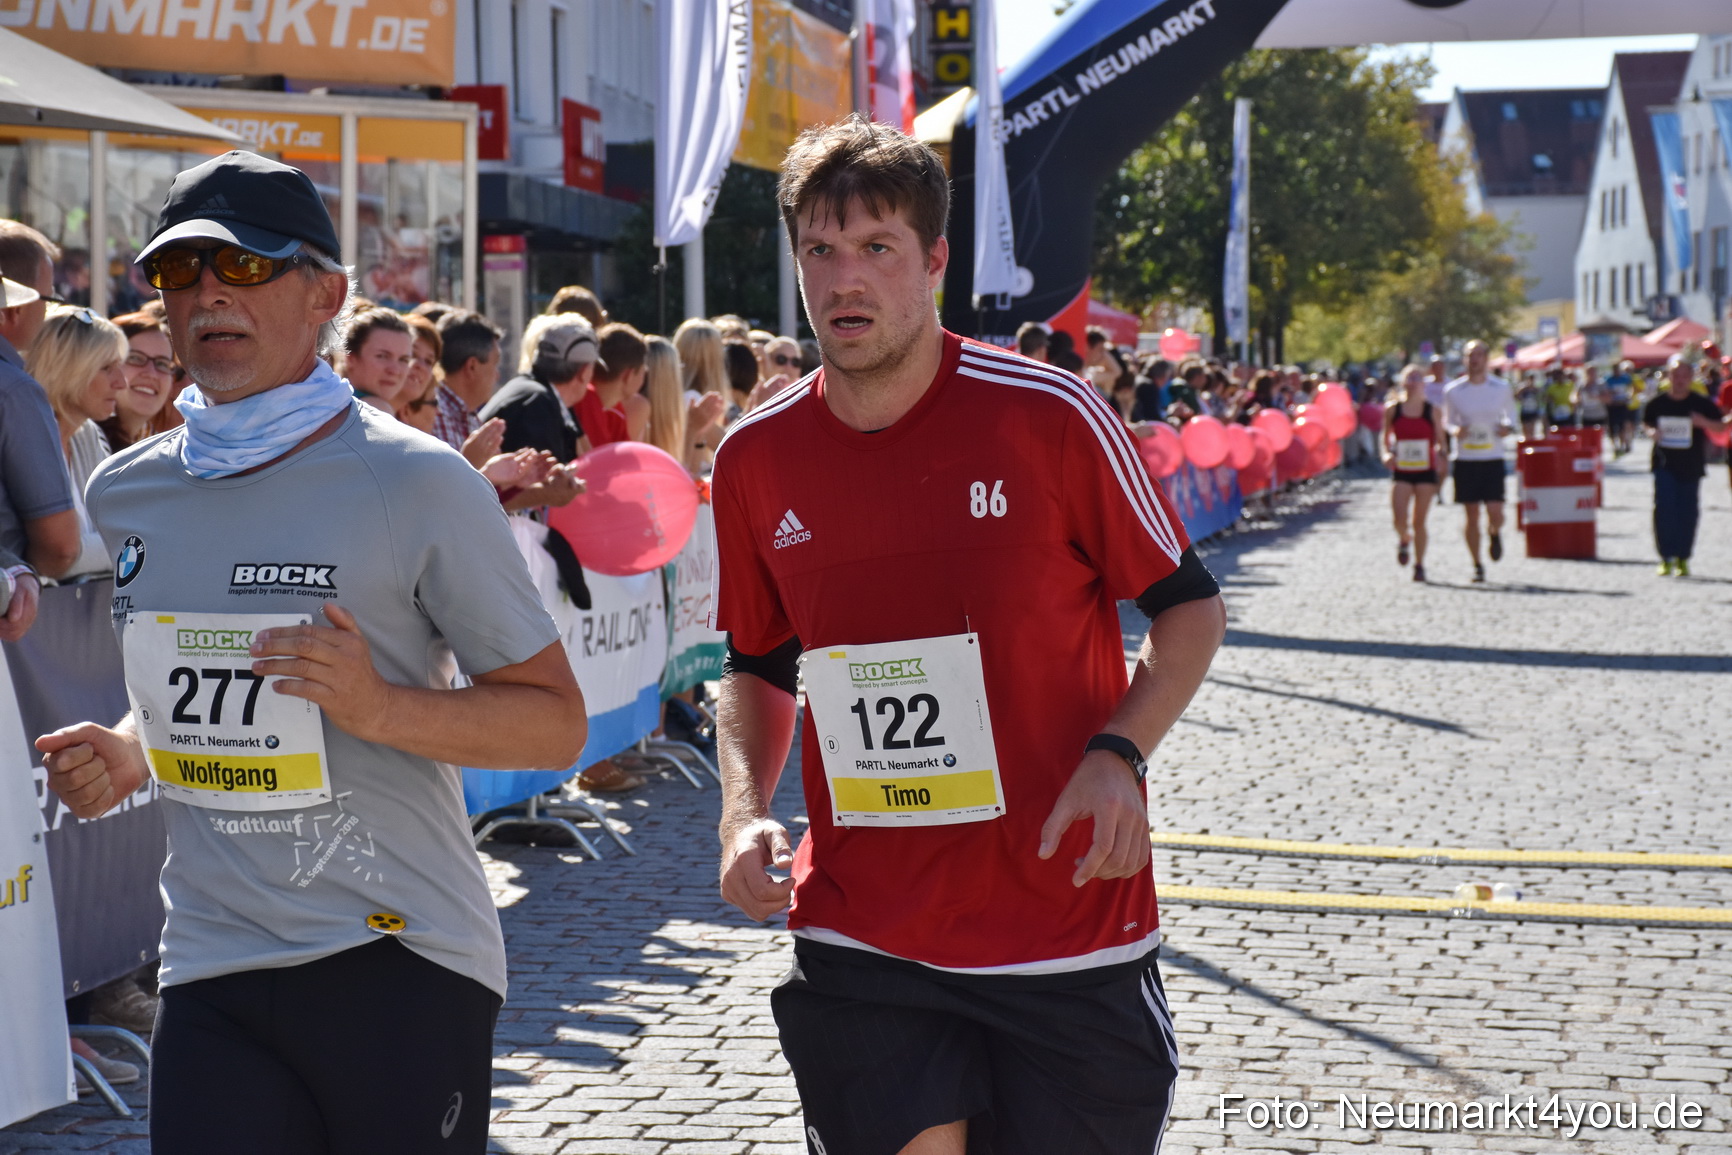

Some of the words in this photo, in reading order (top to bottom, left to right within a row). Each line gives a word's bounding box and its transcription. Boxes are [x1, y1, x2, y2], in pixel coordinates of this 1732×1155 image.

[1001, 85, 1082, 145] PARTL
[1075, 0, 1217, 95] NEUMARKT
[193, 208, 236, 216] adidas
[969, 480, 1008, 519] 86
[773, 529, 812, 550] adidas
[230, 563, 338, 589] BOCK
[228, 587, 257, 597] inspired
[258, 587, 268, 596] by
[296, 589, 338, 600] concepts
[177, 629, 253, 650] BOCK
[177, 650, 201, 658] inspired
[202, 650, 210, 658] by
[849, 658, 926, 681] BOCK
[899, 677, 928, 686] concepts
[168, 666, 265, 726] 277
[850, 693, 946, 750] 122
[170, 733, 206, 746] PARTL
[207, 735, 261, 748] Neumarkt
[177, 759, 278, 791] Wolfgang
[855, 760, 886, 771] PARTL
[888, 758, 940, 770] Neumarkt
[880, 783, 931, 807] Timo
[209, 813, 304, 837] Stadtlauf
[297, 878, 312, 888] 16.
[306, 832, 343, 880] September
[339, 815, 360, 836] 2018
